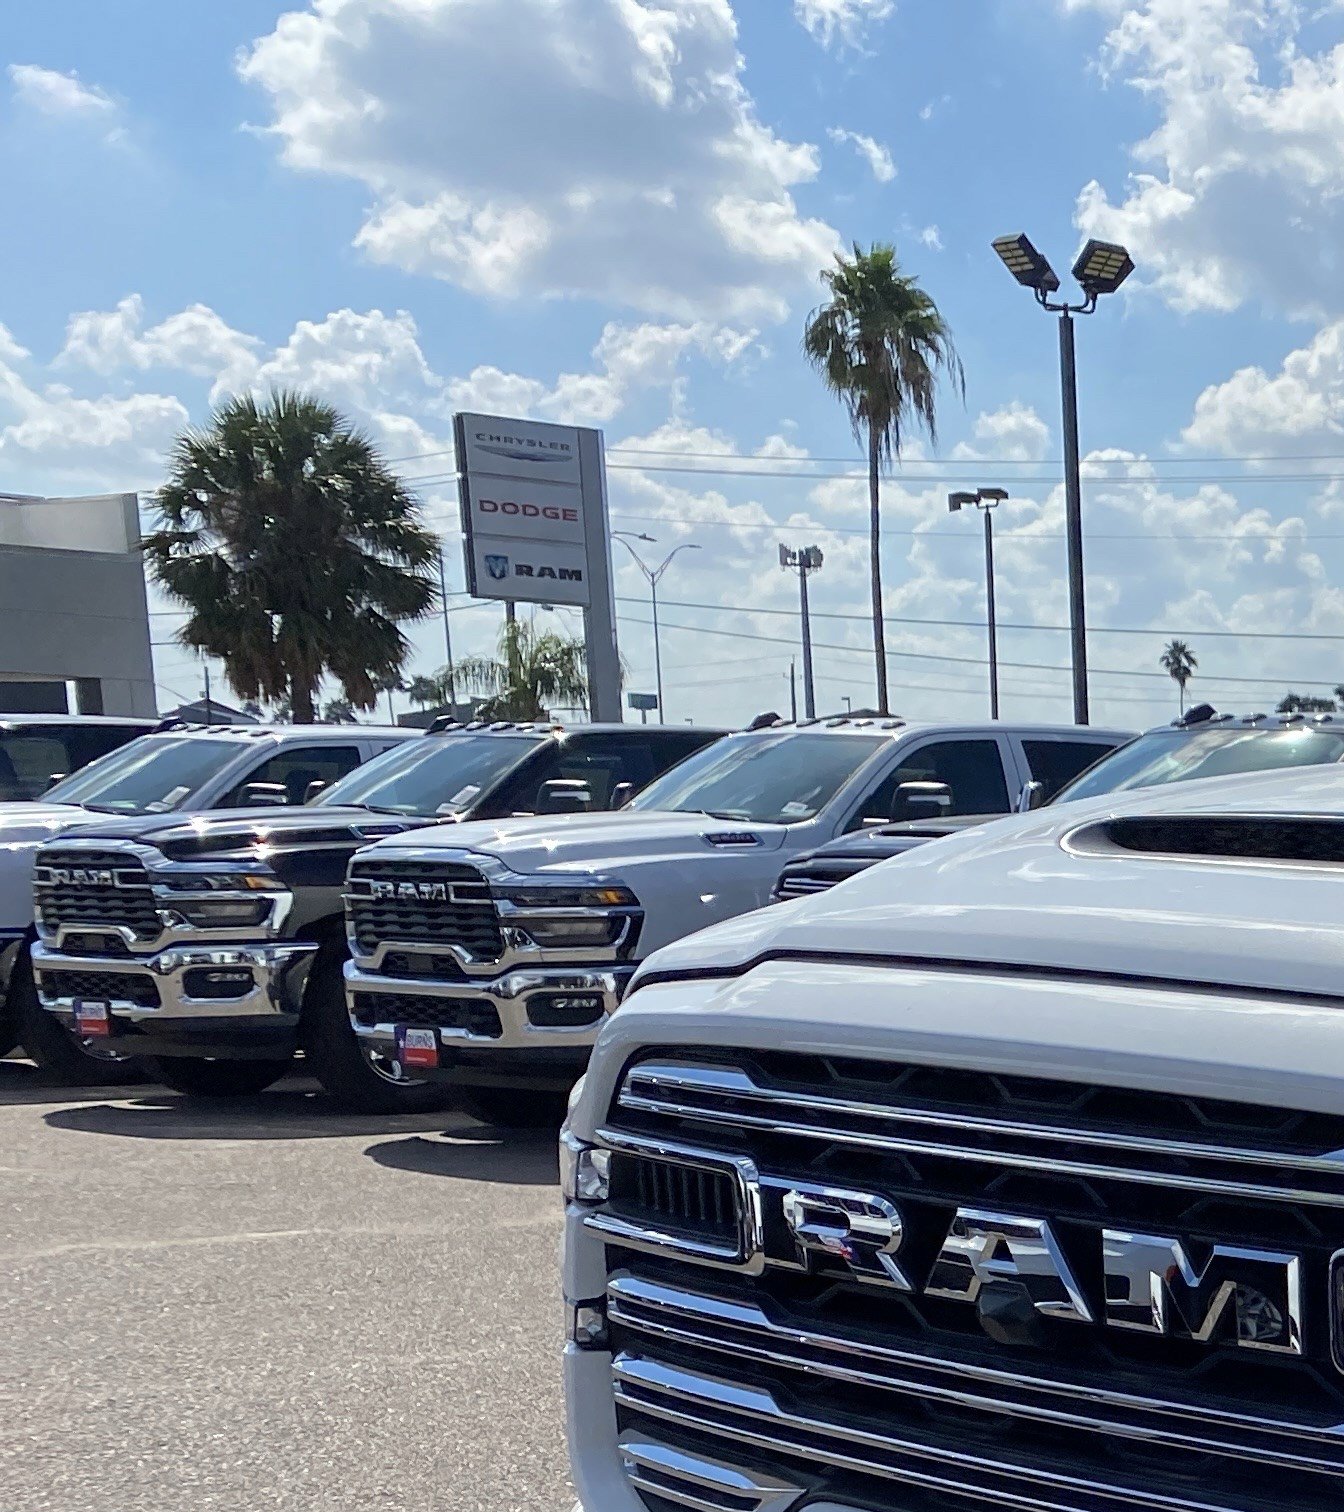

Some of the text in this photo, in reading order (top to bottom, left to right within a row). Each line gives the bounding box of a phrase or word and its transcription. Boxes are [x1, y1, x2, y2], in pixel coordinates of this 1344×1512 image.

[474, 433, 570, 451] CHRYSLER
[478, 500, 579, 521] DODGE
[514, 564, 583, 581] RAM
[371, 880, 447, 900] RAM
[760, 1175, 1302, 1355] RAM
